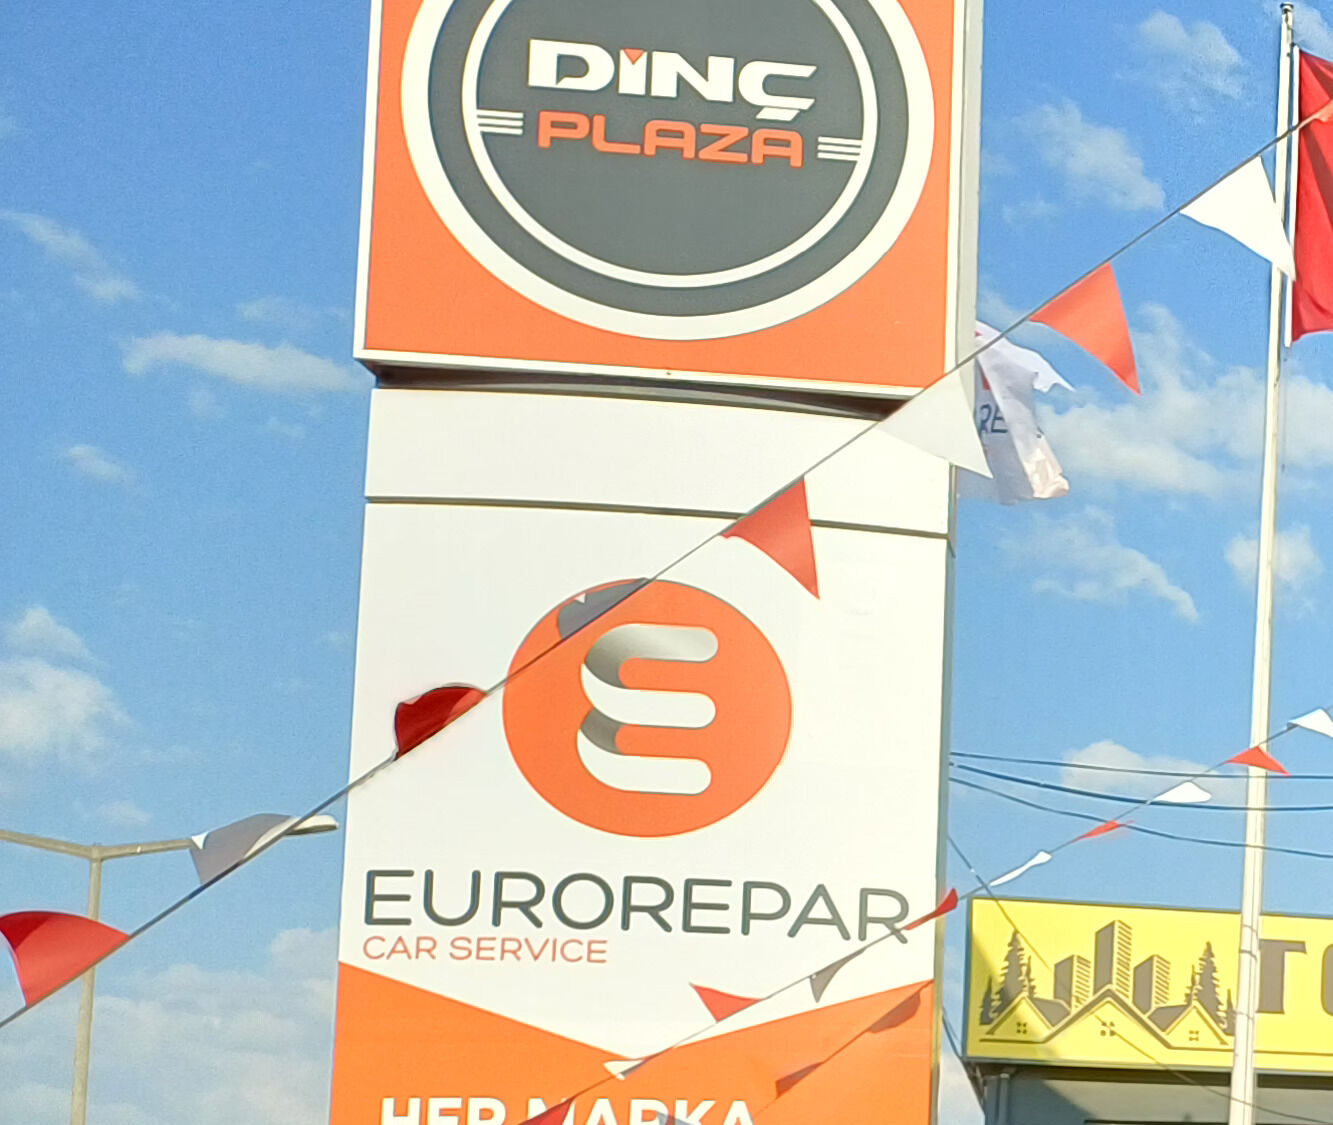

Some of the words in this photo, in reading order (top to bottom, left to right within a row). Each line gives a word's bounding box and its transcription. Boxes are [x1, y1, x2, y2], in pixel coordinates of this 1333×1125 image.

[527, 38, 818, 121] DİNÇ
[537, 110, 804, 167] PLAZA
[363, 869, 910, 944] EUROREPAR
[362, 935, 438, 961] CAR
[449, 936, 608, 964] SERVICE
